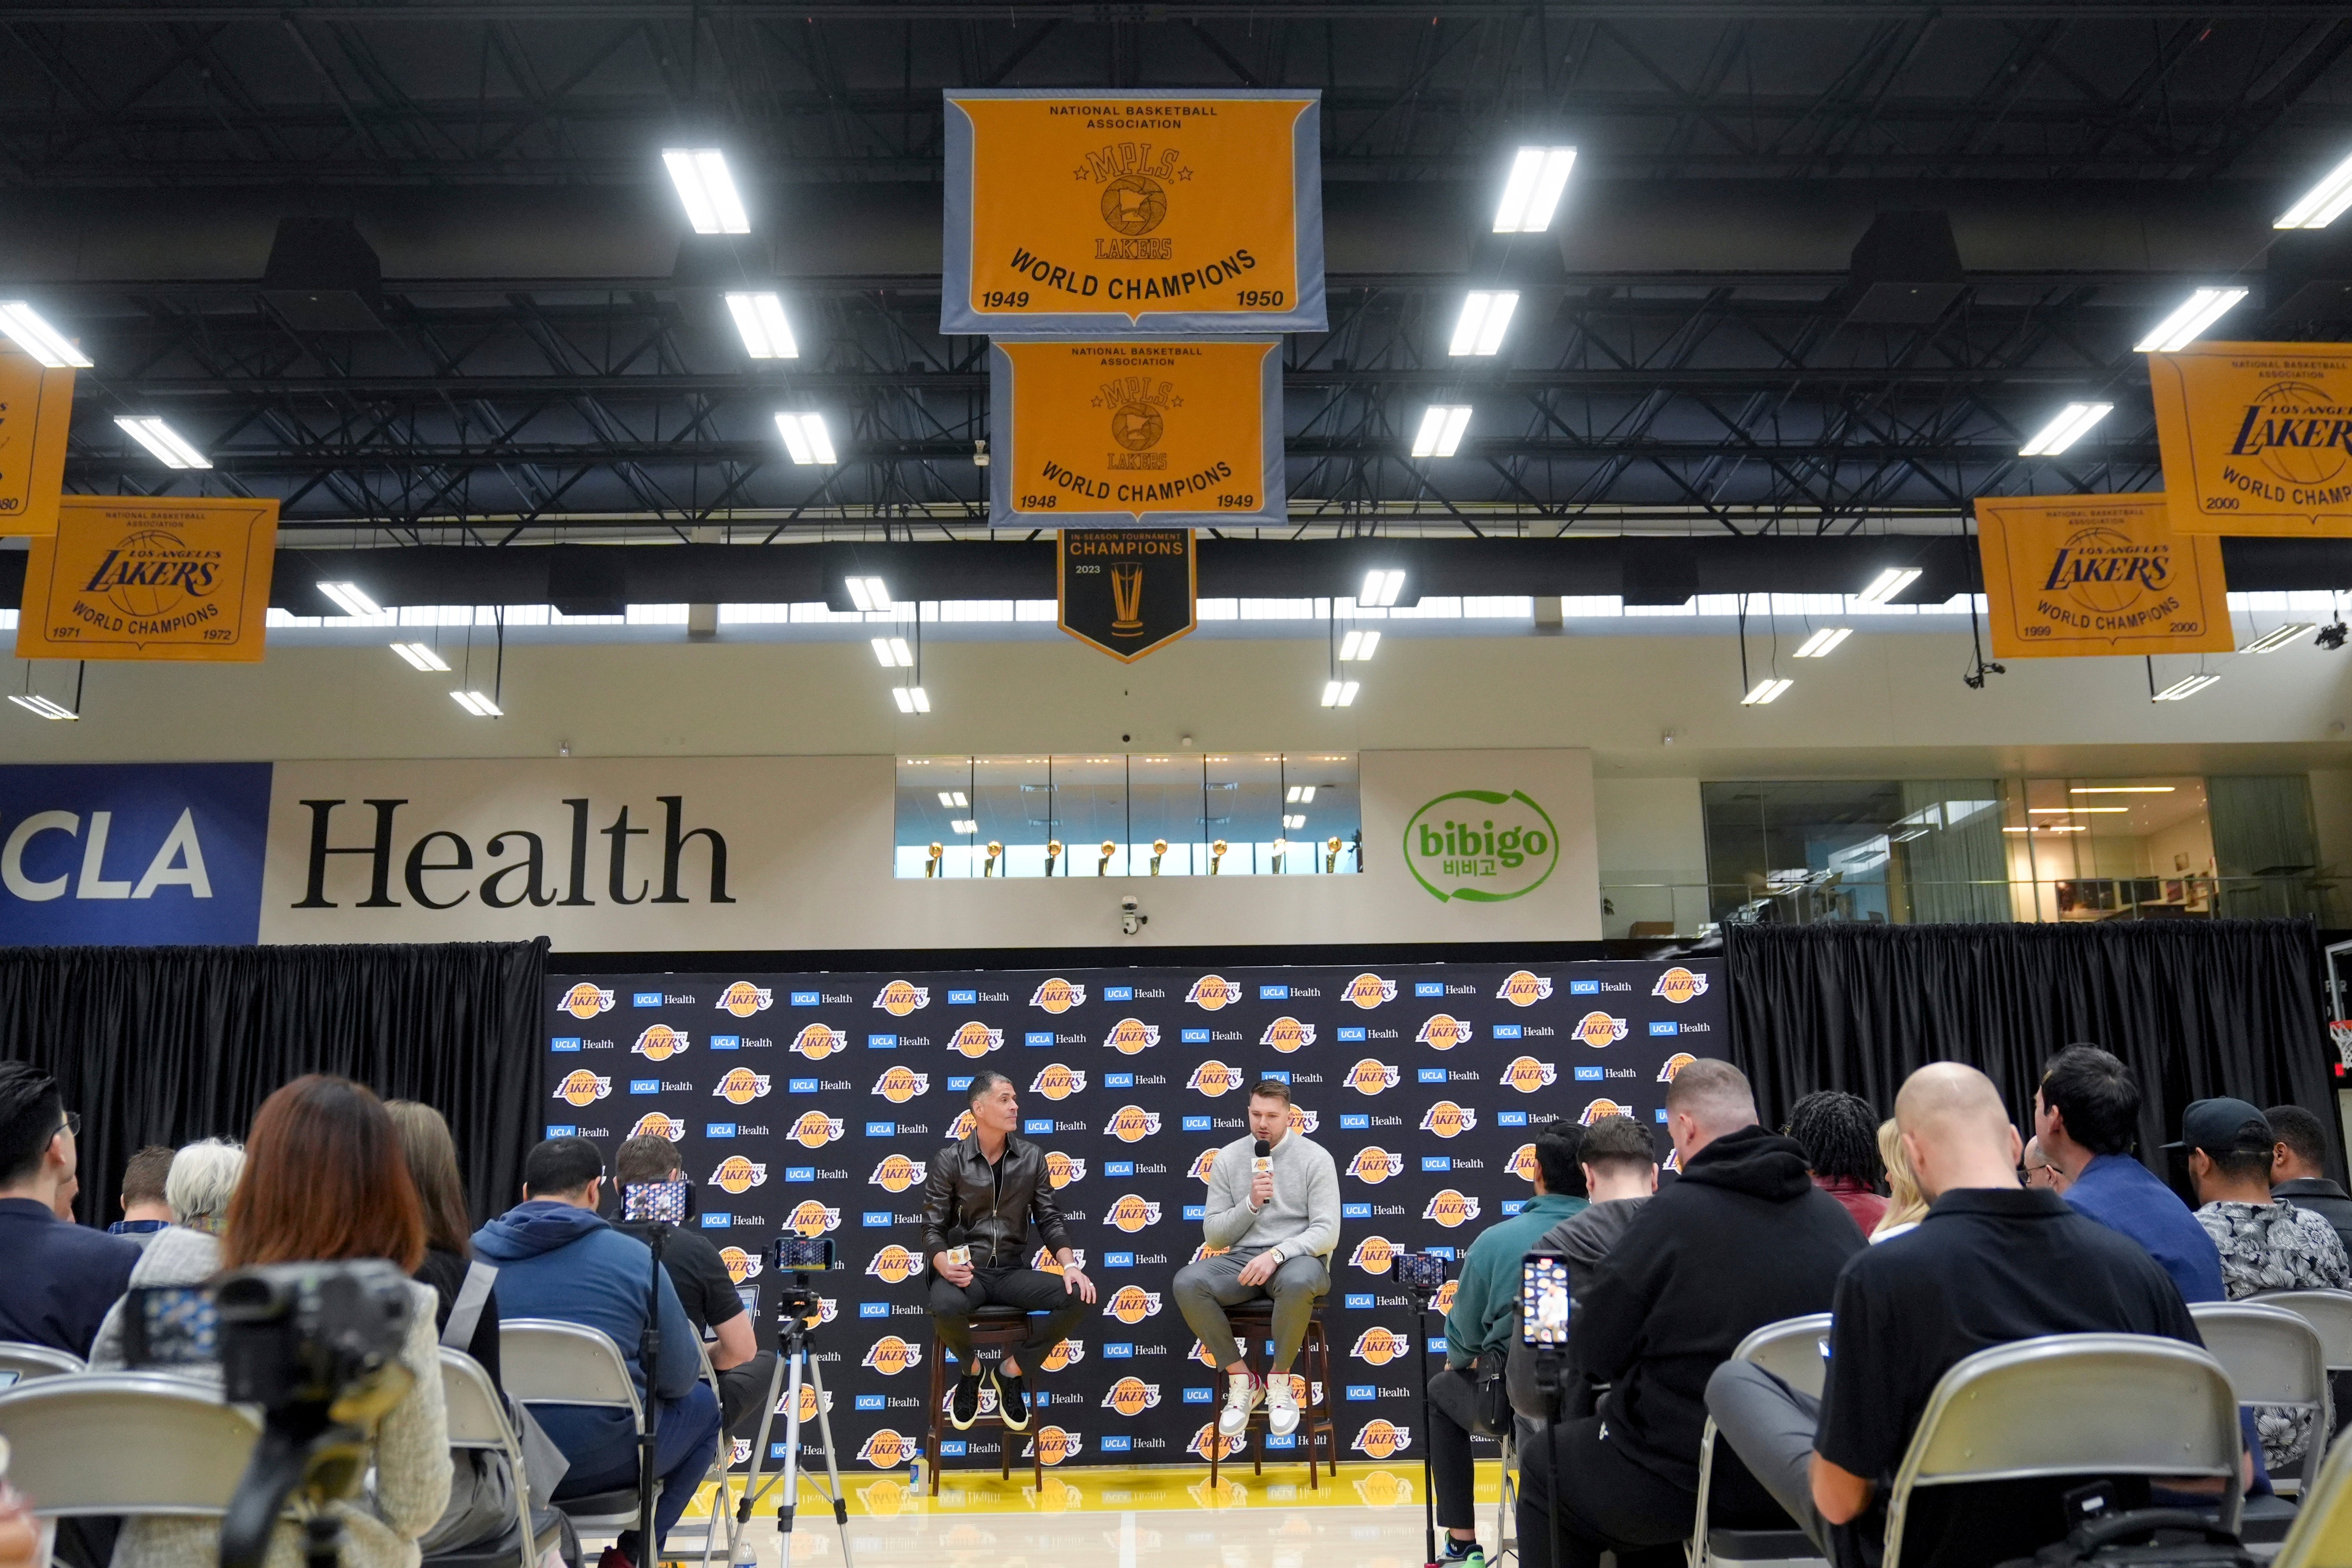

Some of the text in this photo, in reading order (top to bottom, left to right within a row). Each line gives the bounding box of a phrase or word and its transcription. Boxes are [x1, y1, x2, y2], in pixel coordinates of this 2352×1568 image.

[1050, 106, 1217, 116] NATIONAL BASKETBALL
[1087, 119, 1181, 129] ASSOCIATION
[1086, 142, 1179, 184] MPLS.
[1095, 238, 1172, 259] LAKERS
[1010, 247, 1255, 300] WORLD CHAMPIONS
[983, 292, 1029, 307] 1949
[1237, 291, 1283, 306] 1950
[2271, 405, 2299, 414] LOS
[1107, 453, 1167, 470] LAKERS
[1042, 461, 1232, 502] WORLD CHAMPIONS
[2224, 465, 2285, 502] WORLD
[0, 498, 18, 510] 80
[1021, 496, 1056, 508] 1948
[1217, 495, 1253, 507] 1949
[2207, 498, 2239, 509] 2000
[1070, 542, 1183, 555] CHAMPIONS
[2106, 545, 2169, 554] ANGELES
[80, 550, 219, 596] LAKERS
[1076, 565, 1100, 574] 2023
[2039, 547, 2169, 591] LAKERS
[72, 600, 218, 634] WORLD CHAMPIONS
[2037, 597, 2180, 629] WORLD CHAMPIONS
[53, 628, 80, 638] 1971
[2024, 626, 2051, 636] 1999
[2170, 622, 2197, 632] 2000
[203, 630, 231, 640] 1972
[1419, 820, 1548, 868] bibigo
[291, 796, 736, 909] Health
[1444, 860, 1497, 877] 비비고
[1344, 983, 1393, 999] LAKERS
[1445, 985, 1476, 994] Health
[1655, 976, 1704, 994] LAKERS
[877, 989, 926, 1007] LAKERS
[978, 992, 1009, 1002] Health
[1135, 989, 1165, 998] Health
[1290, 987, 1321, 997] Health
[561, 992, 611, 1009] LAKERS
[665, 994, 696, 1004] Health
[795, 994, 853, 1003] UCLA Health
[1679, 1023, 1710, 1033] Health
[1422, 1070, 1480, 1081] UCLA Health
[1503, 1066, 1552, 1083] LAKERS
[661, 1081, 693, 1091] Health
[717, 1077, 767, 1095] LAKERS
[820, 1080, 852, 1090] Health
[1028, 1121, 1087, 1131] UCLA Health
[1108, 1115, 1157, 1132] LAKERS
[1186, 1118, 1244, 1128] UCLA Health
[1371, 1116, 1402, 1125] Health
[1425, 1159, 1484, 1169] UCLA Health
[713, 1165, 763, 1184] LAKERS
[789, 1169, 848, 1179] UCLA Health
[1108, 1205, 1157, 1223] LAKERS
[1426, 1199, 1476, 1217] LAKERS
[705, 1215, 765, 1226] UCLA Health
[870, 1255, 920, 1273] LAKERS
[1108, 1254, 1167, 1264] UCLA Health
[1107, 1295, 1158, 1313] LAKERS
[1349, 1295, 1408, 1306] UCLA Health
[863, 1305, 924, 1315] UCLA Health
[1107, 1345, 1167, 1355] UCLA Health
[1354, 1337, 1405, 1355] LAKERS
[866, 1346, 917, 1365] LAKERS
[1105, 1387, 1156, 1405] LAKERS
[1350, 1387, 1410, 1398] UCLA Health
[859, 1397, 920, 1407] UCLA Health
[1105, 1438, 1166, 1448] UCLA Health
[1355, 1430, 1407, 1448] LAKERS
